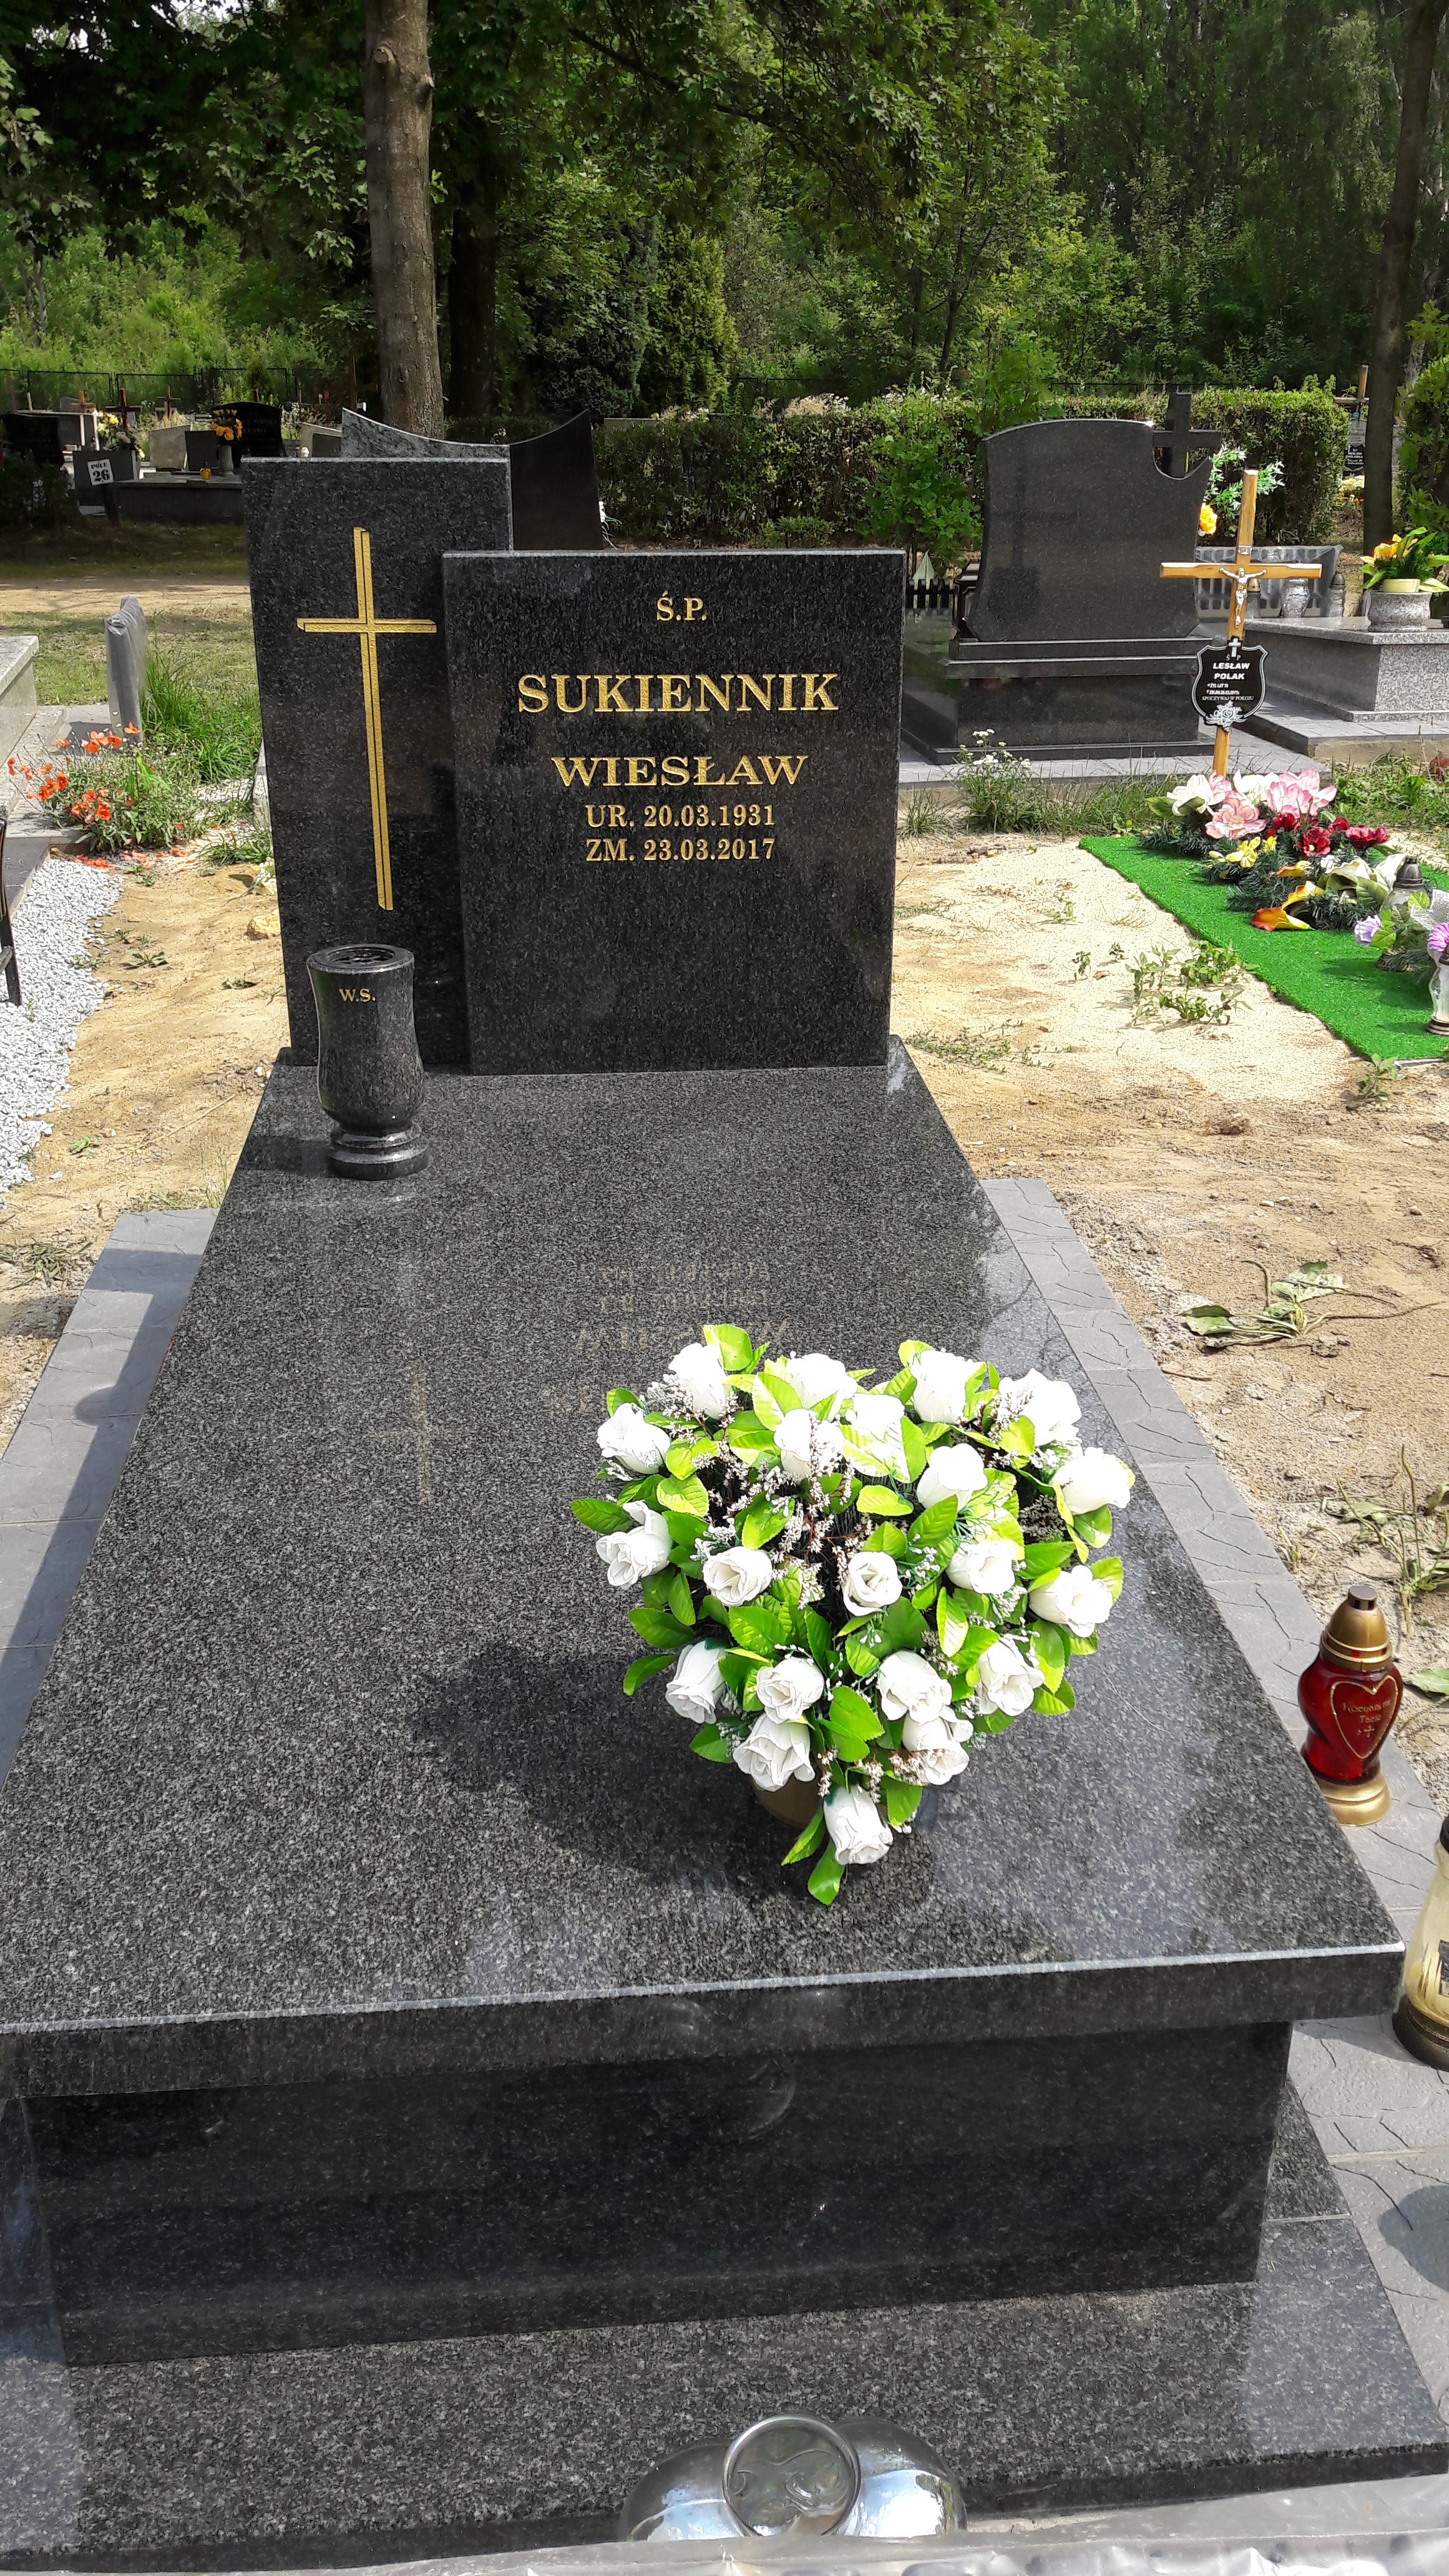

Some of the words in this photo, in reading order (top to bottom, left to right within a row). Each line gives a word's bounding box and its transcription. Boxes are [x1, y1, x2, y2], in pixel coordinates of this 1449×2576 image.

[93, 469, 110, 482] 26
[656, 591, 707, 622] Ś.P.
[518, 673, 839, 713] SUKIENNIK
[552, 755, 808, 787] WIESŁAW
[585, 804, 635, 828] UR.
[643, 804, 774, 827] 20.03.1931
[585, 839, 635, 862] ZM.
[643, 838, 776, 861] 23.03.2017
[338, 988, 376, 1003] W.S.
